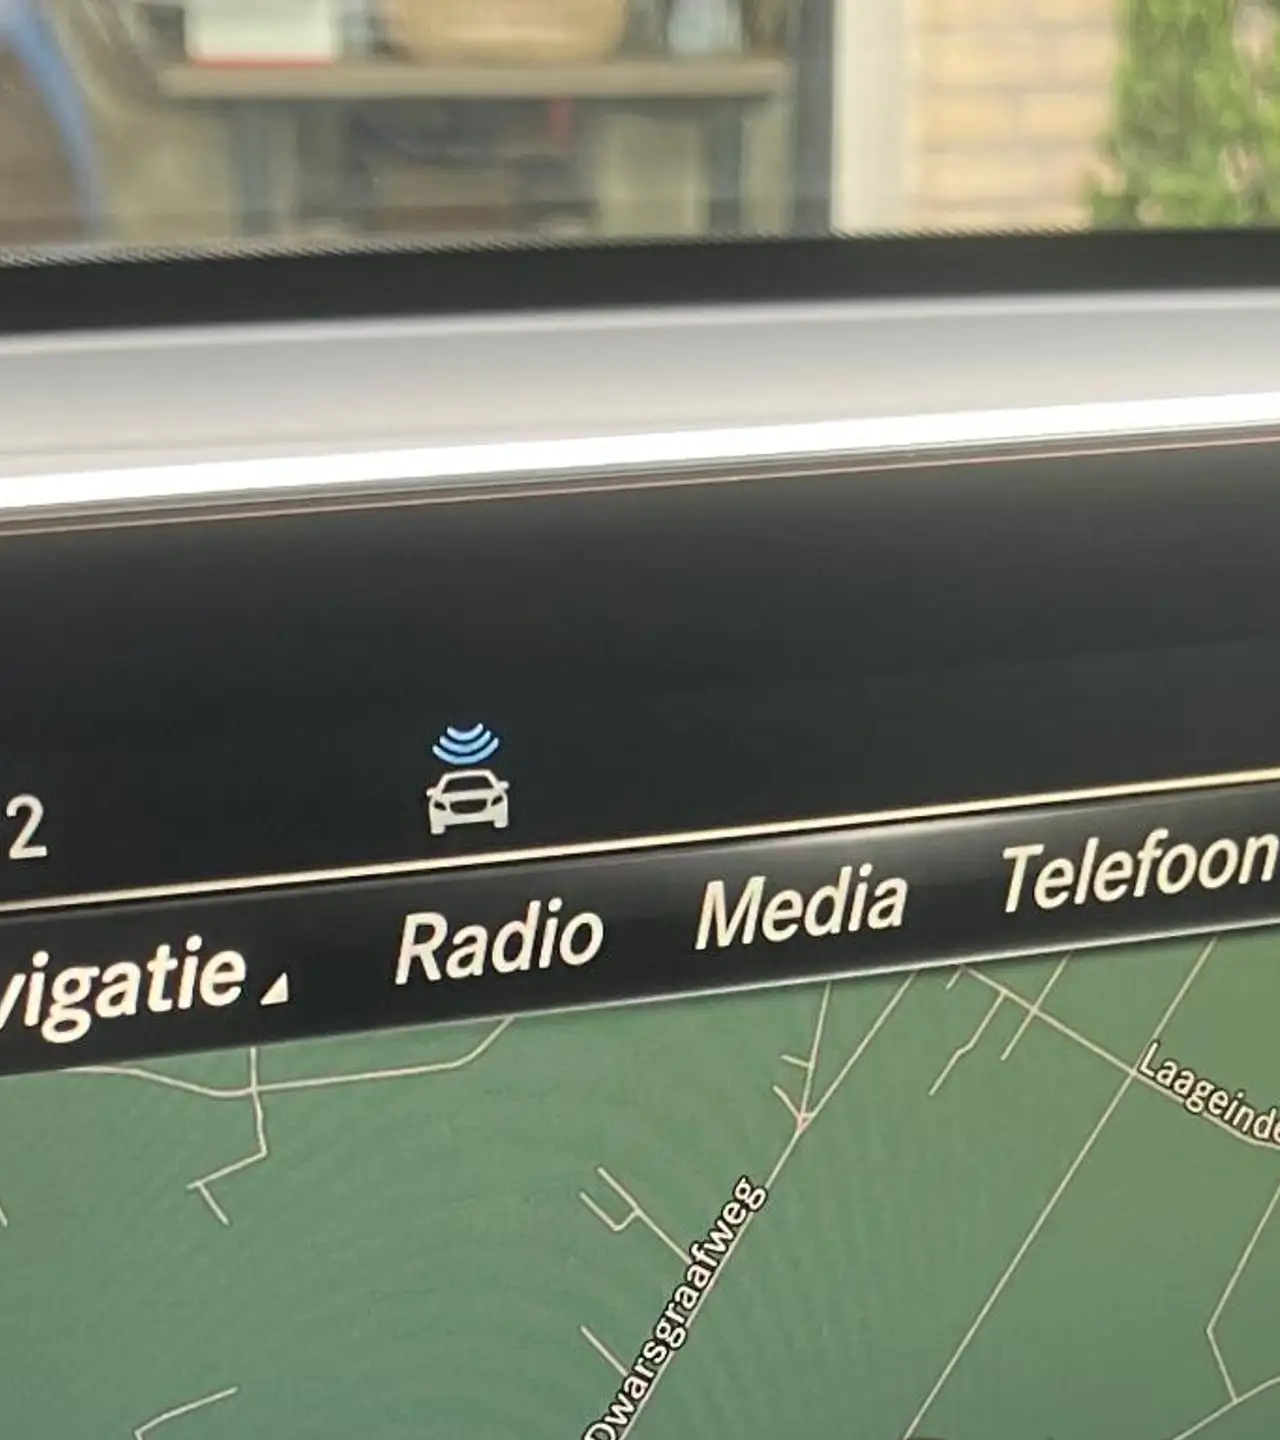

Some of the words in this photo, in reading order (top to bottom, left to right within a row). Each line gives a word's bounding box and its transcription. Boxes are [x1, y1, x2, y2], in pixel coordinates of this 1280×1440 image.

[394, 897, 604, 985] Radio
[694, 862, 909, 950] Media
[1001, 827, 1280, 914] Telefoon
